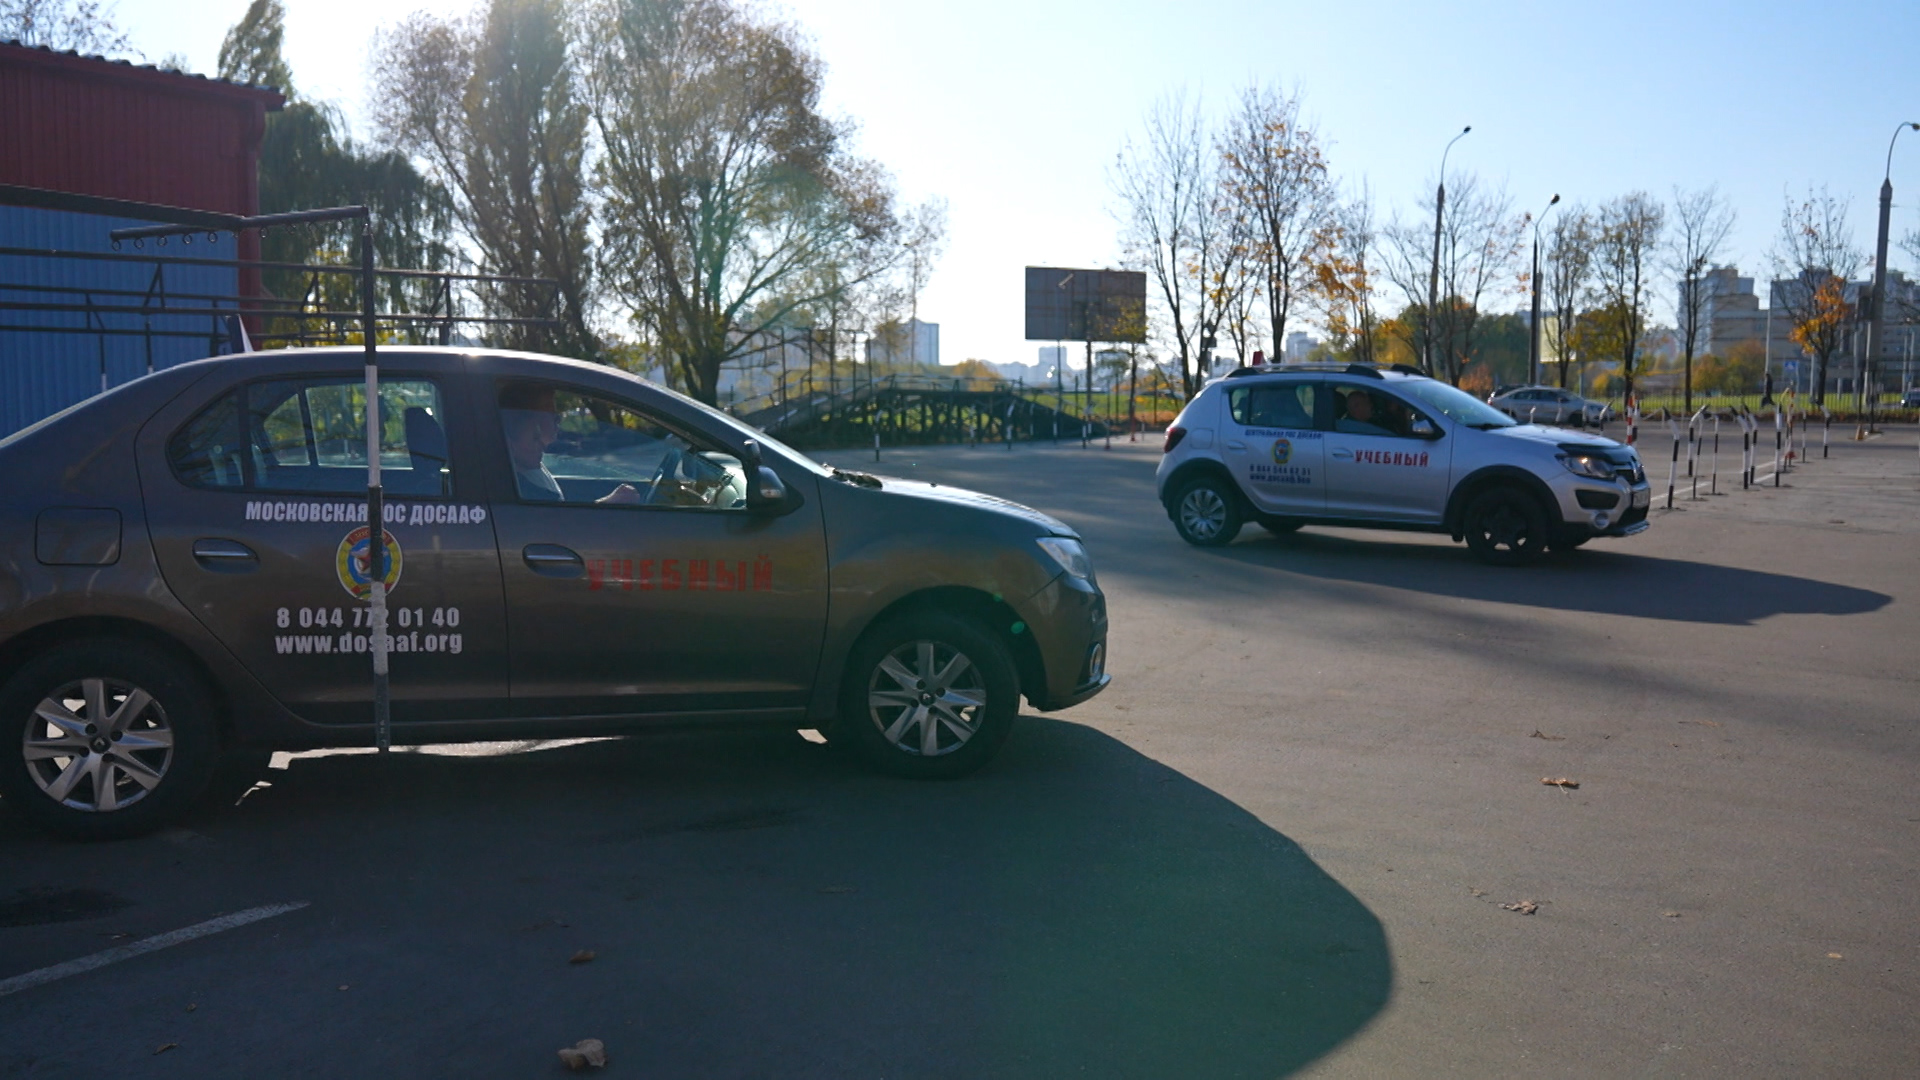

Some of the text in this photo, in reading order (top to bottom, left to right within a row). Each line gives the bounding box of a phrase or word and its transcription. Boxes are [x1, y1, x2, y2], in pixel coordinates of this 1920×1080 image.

[1355, 450, 1429, 467] УЧЕБНЫЙ
[245, 501, 487, 526] МОСКОВСКАЯ ОС ДОСААФ
[587, 554, 773, 592] УЧЕБНЫЙ
[276, 607, 460, 628] 8 044 77 01 40
